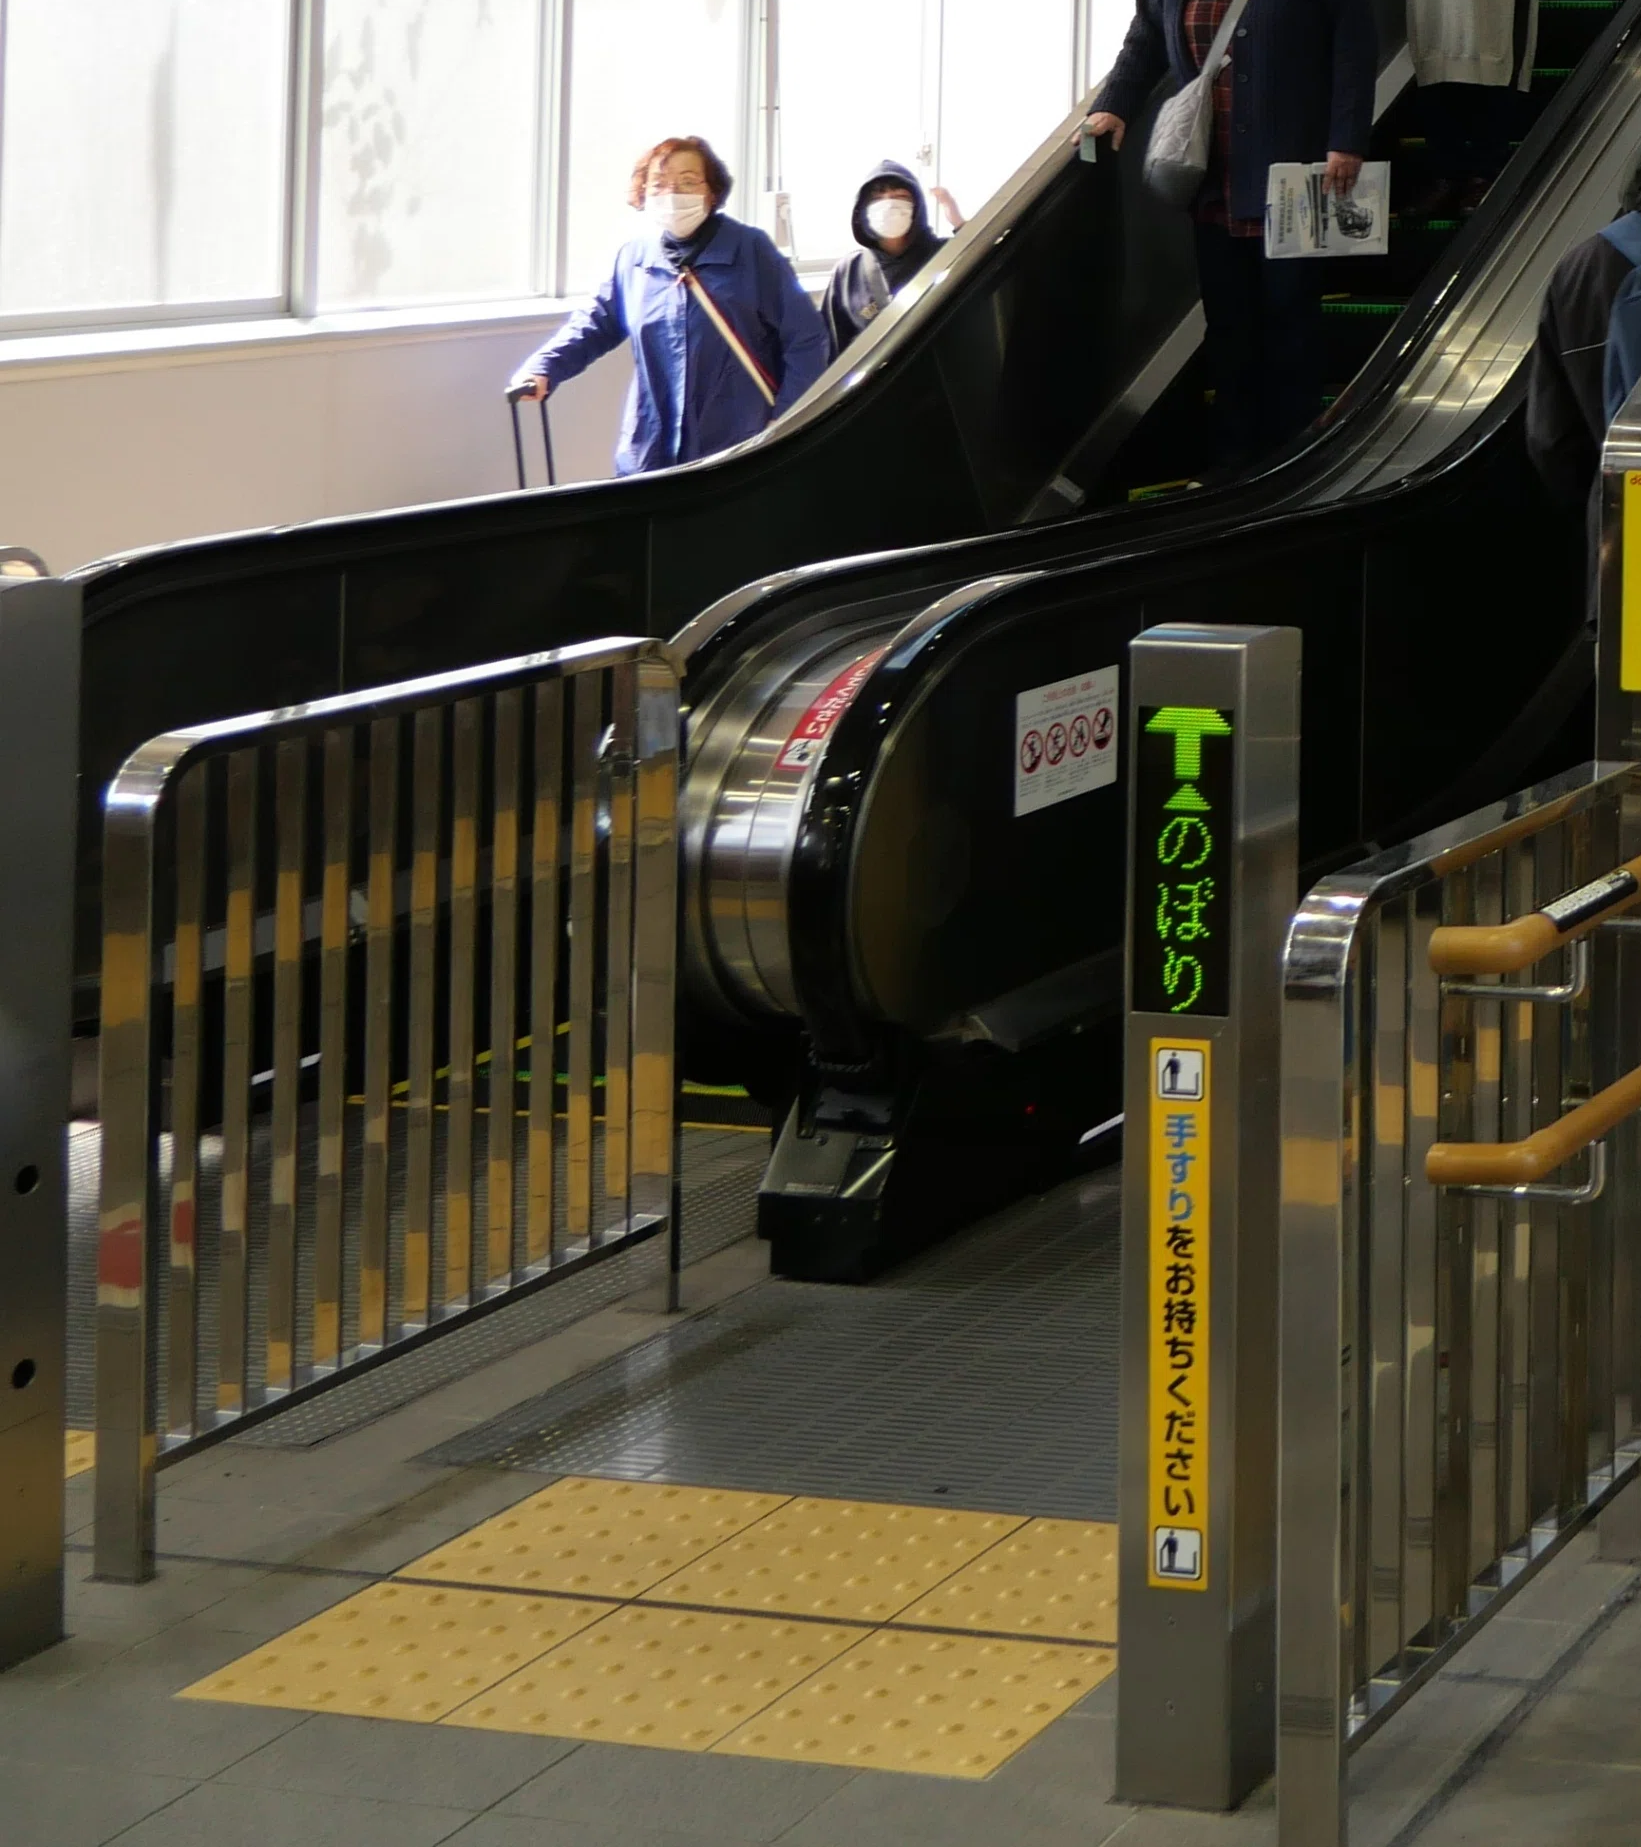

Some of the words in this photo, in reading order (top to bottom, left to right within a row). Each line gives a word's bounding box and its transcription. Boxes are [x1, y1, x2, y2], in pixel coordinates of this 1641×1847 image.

[1157, 817, 1215, 1013] のぼり
[1163, 1112, 1198, 1518] 手すりをお持ちください
